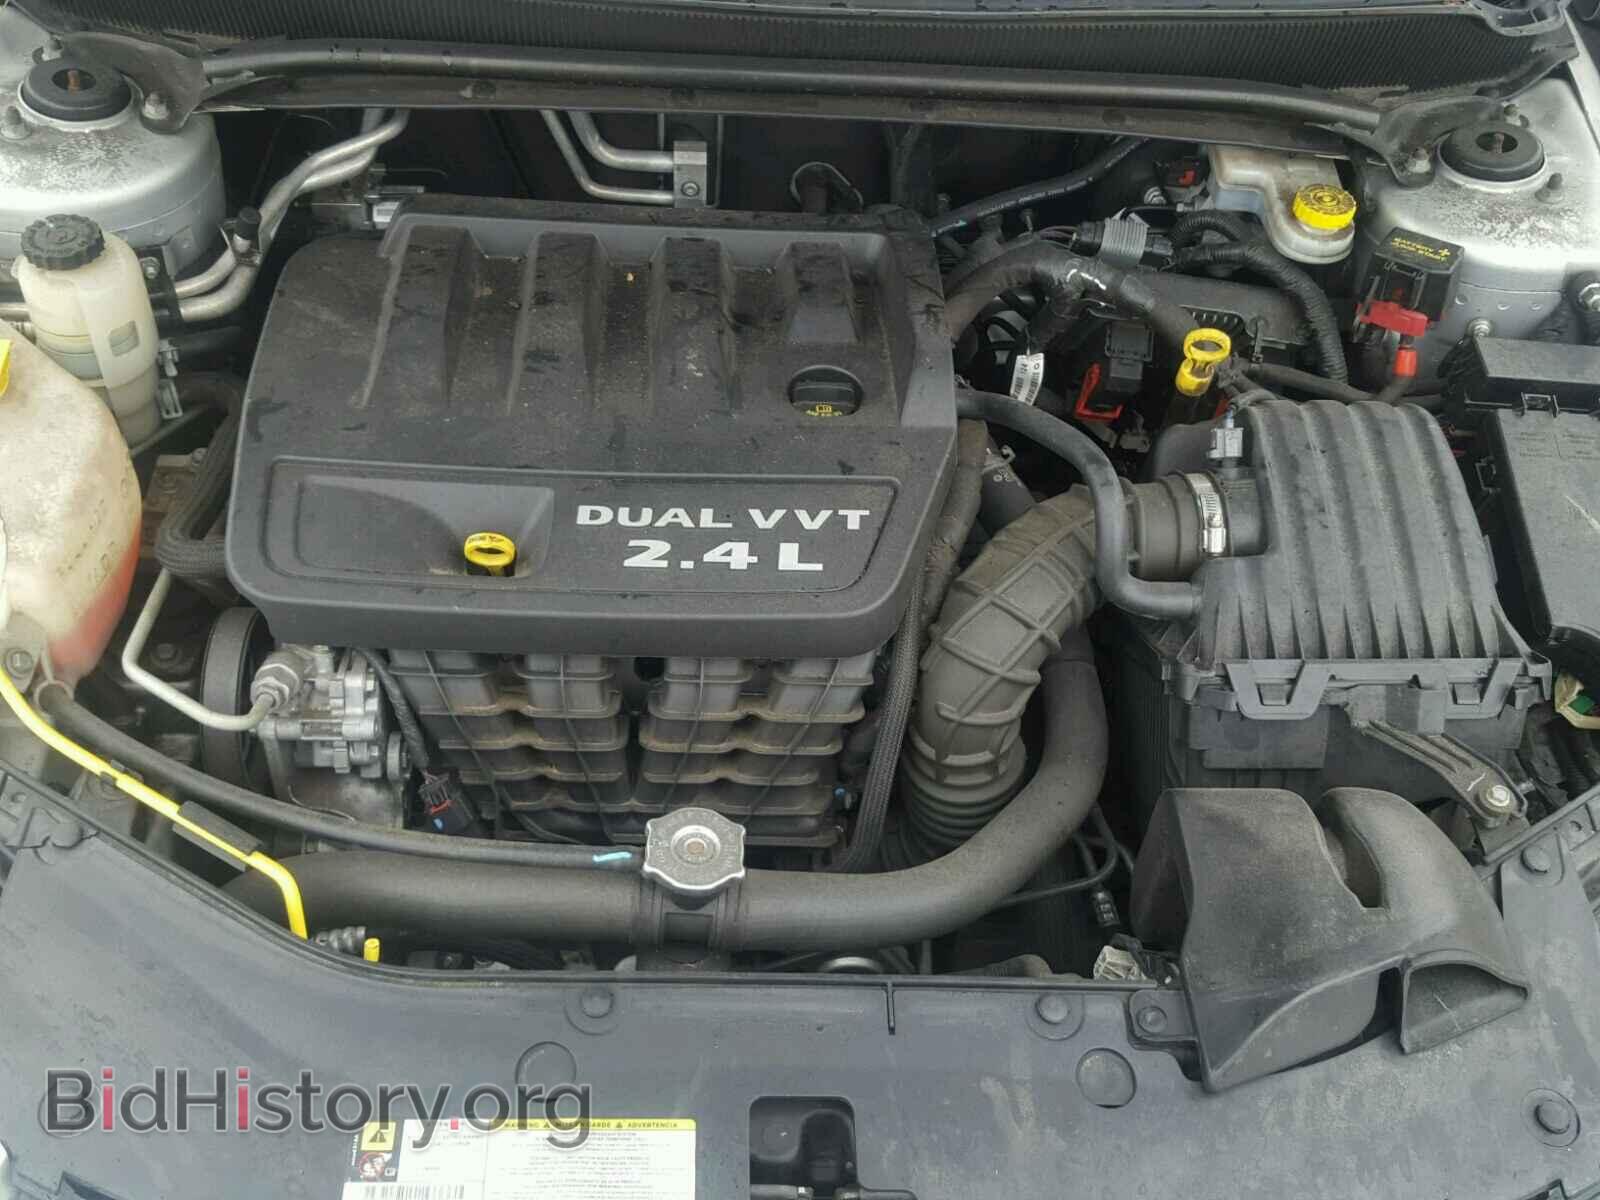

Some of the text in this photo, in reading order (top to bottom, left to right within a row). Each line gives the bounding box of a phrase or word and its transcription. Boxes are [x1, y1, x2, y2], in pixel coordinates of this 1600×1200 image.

[576, 505, 870, 530] DUAL VVT
[623, 539, 758, 570] 2.4
